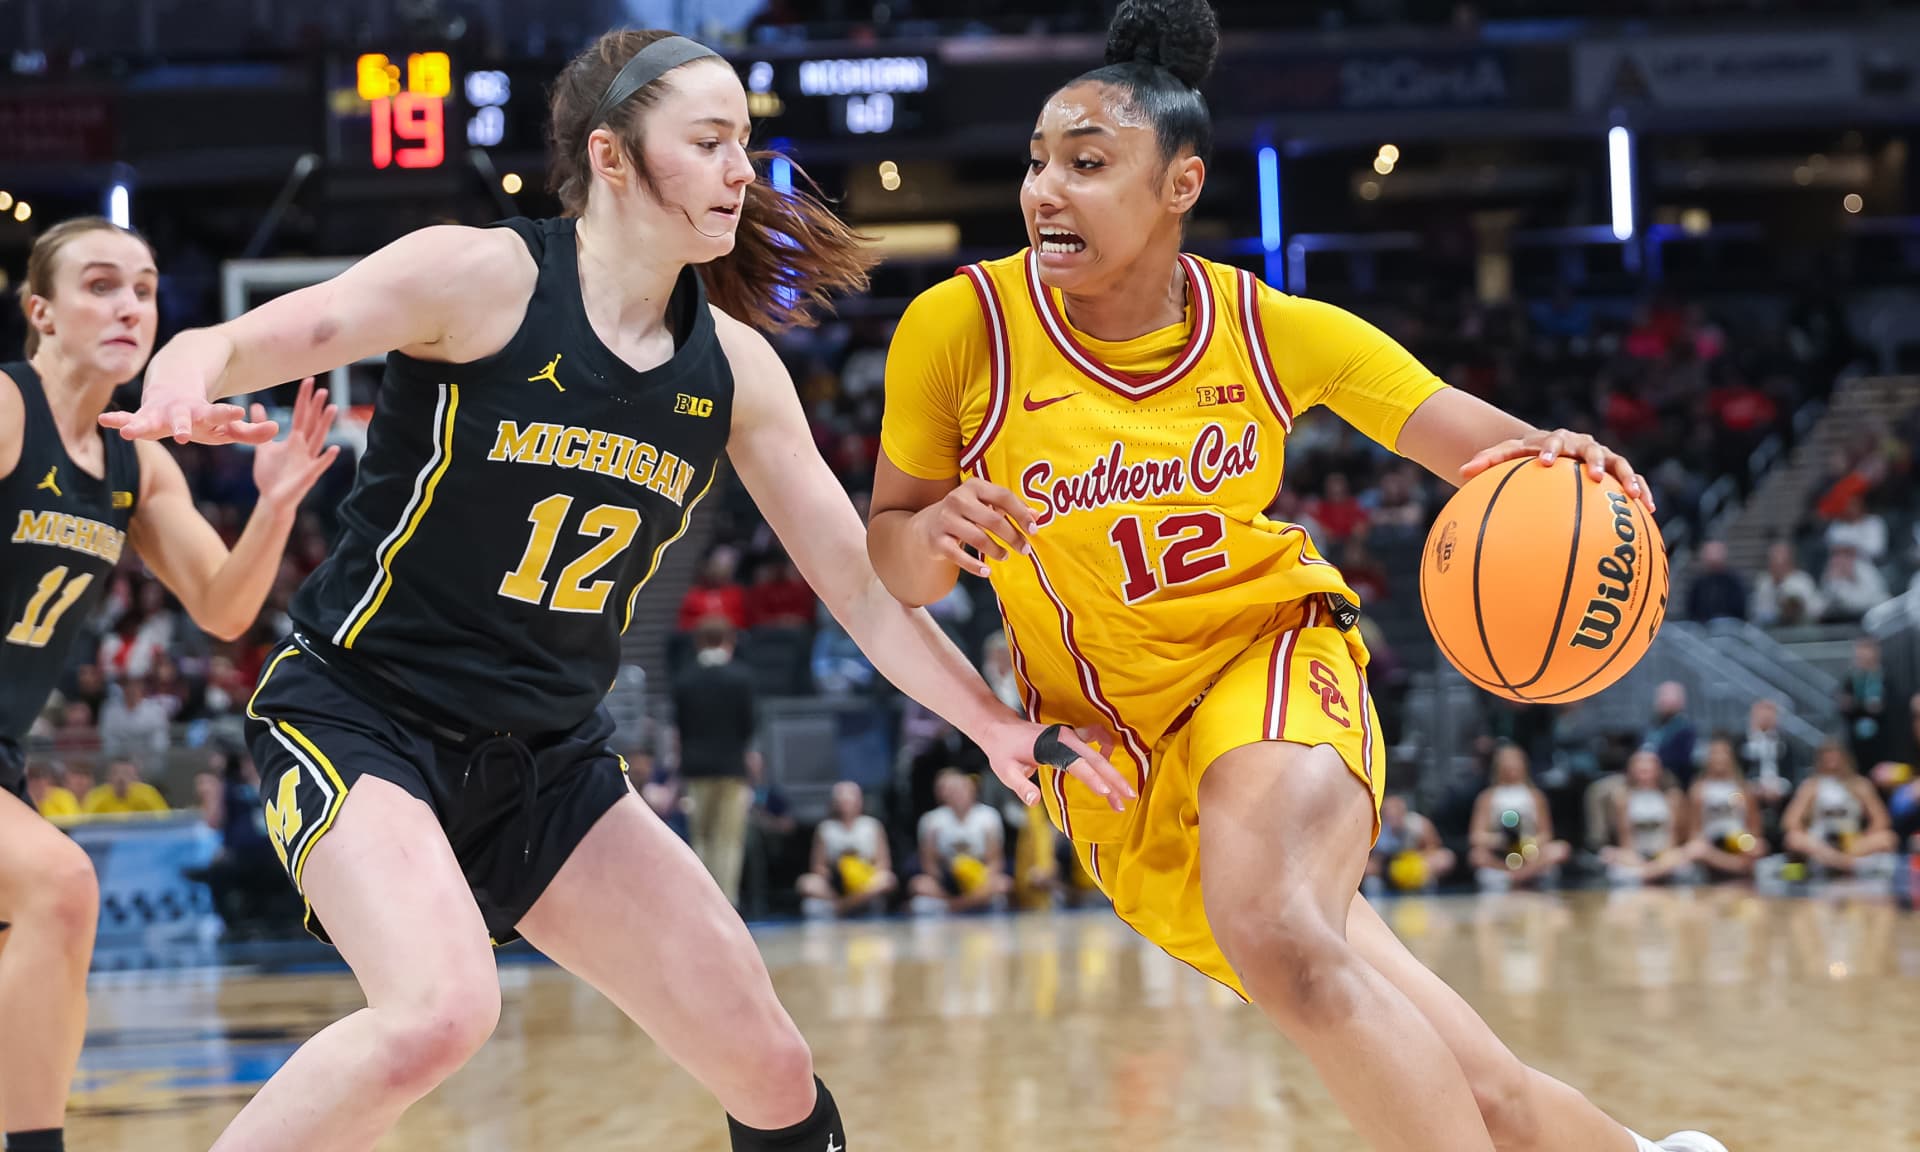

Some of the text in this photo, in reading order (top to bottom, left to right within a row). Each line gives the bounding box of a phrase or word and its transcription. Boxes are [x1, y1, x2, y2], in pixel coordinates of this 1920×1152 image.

[372, 91, 445, 170] 19
[487, 420, 695, 507] MICHIGAN
[1021, 422, 1258, 529] Southern Cal
[498, 493, 642, 614] 12
[1109, 510, 1230, 606] 12
[1568, 490, 1637, 651] Wilson
[6, 565, 94, 648] 11
[1340, 611, 1355, 625] 46
